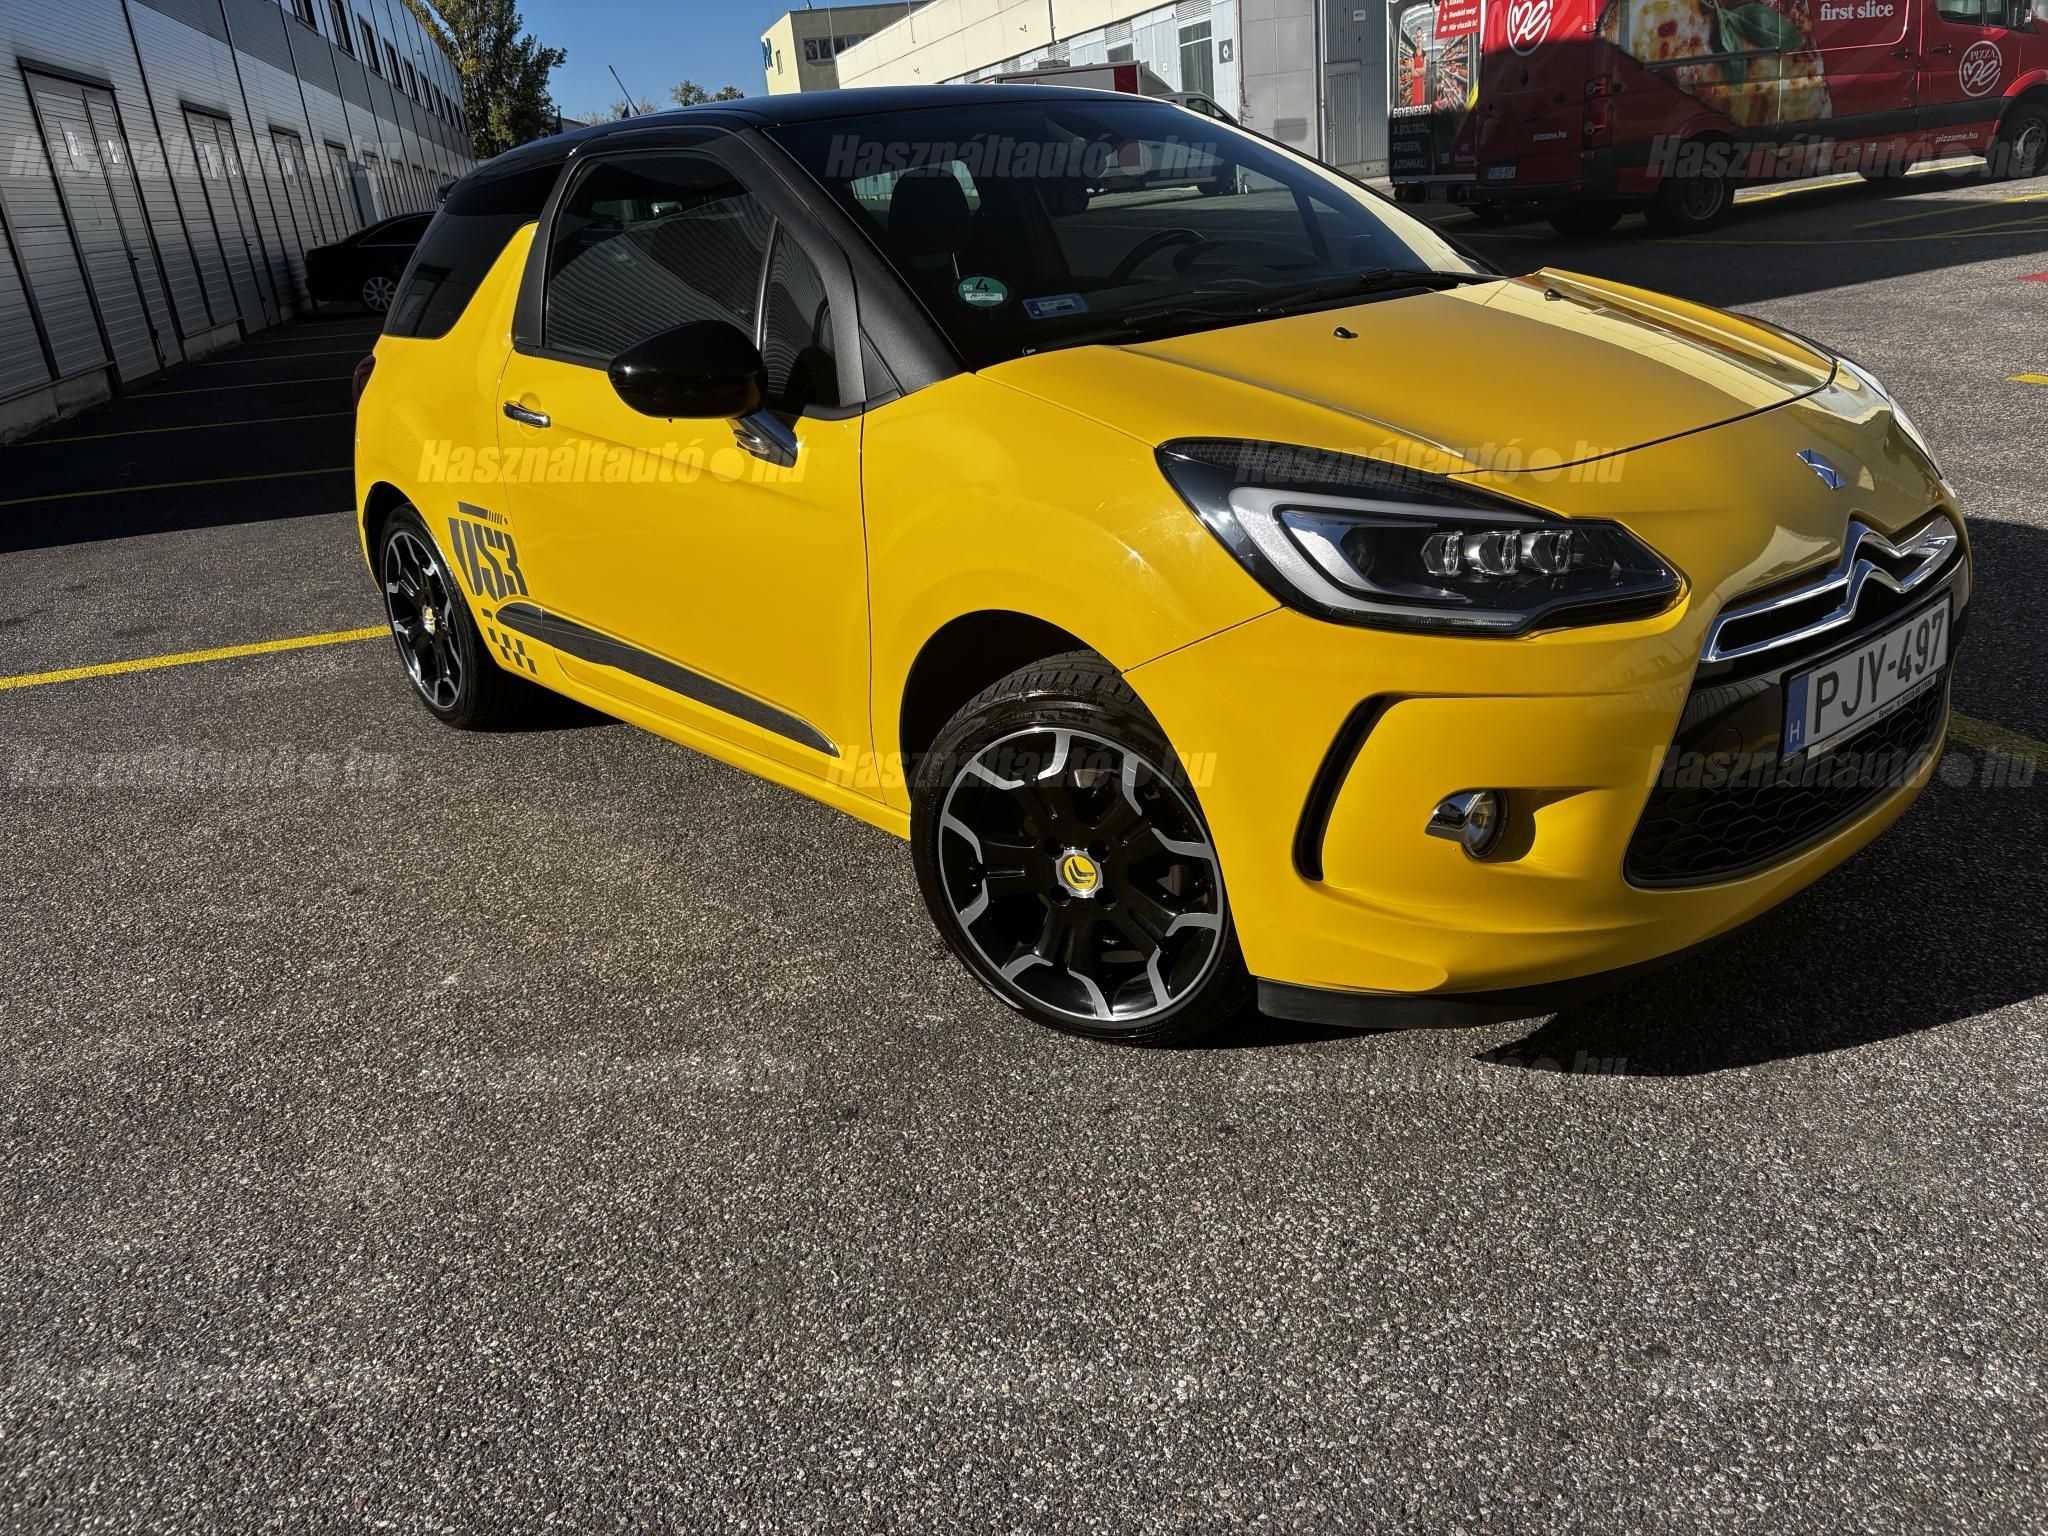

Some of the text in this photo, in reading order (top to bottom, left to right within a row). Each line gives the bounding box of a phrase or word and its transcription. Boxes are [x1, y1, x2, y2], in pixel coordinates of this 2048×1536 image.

[1820, 0, 1894, 21] first slice
[1970, 49, 1996, 61] PIZZA
[1392, 104, 1432, 118] EGYENESEN
[1935, 131, 1979, 145] pizzame.hu
[975, 278, 990, 292] 4
[447, 517, 530, 603] DS3
[1813, 607, 1946, 735] PJY-497
[1878, 704, 1895, 719] Speyer
[1789, 719, 1801, 744] H
